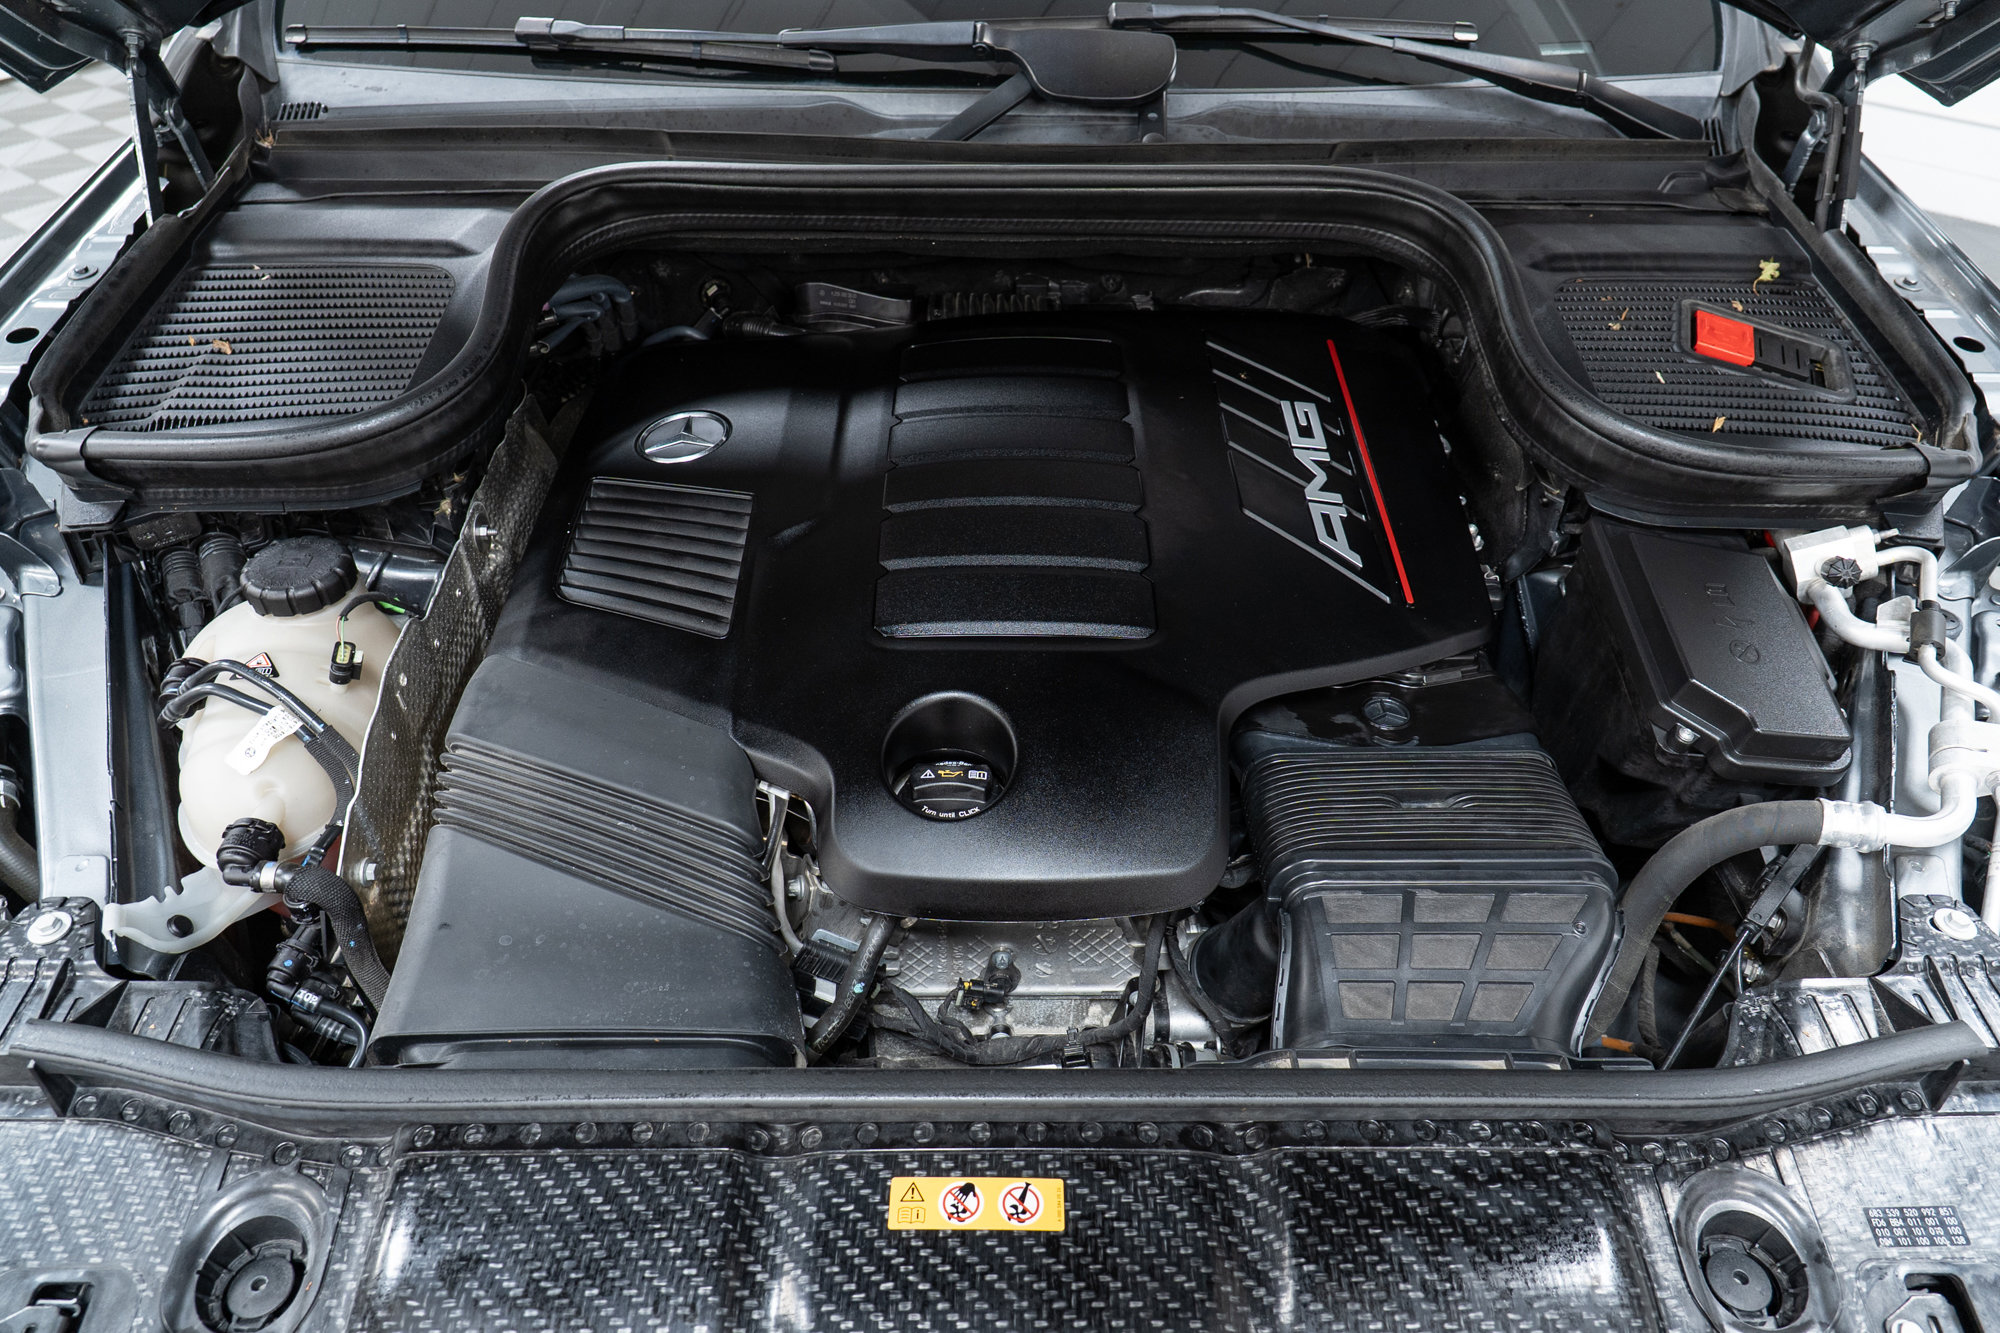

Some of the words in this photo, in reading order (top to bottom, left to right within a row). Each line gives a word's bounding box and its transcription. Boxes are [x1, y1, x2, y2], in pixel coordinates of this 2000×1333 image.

[1280, 400, 1363, 568] AMG
[921, 805, 937, 816] Turn
[958, 806, 981, 817] CLICK
[1868, 1209, 1883, 1218] 683
[1885, 1209, 1900, 1217] 539
[1903, 1208, 1919, 1217] 520
[1921, 1208, 1936, 1216] 992
[1938, 1207, 1954, 1216] 851
[1907, 1218, 1922, 1226] 011
[1924, 1217, 1940, 1226] 001
[1943, 1217, 1958, 1225] 100
[1875, 1228, 1890, 1236] 010
[1912, 1227, 1926, 1236] 101
[1947, 1226, 1962, 1235] 100
[1897, 1237, 1912, 1246] 101
[1915, 1237, 1930, 1245] 100
